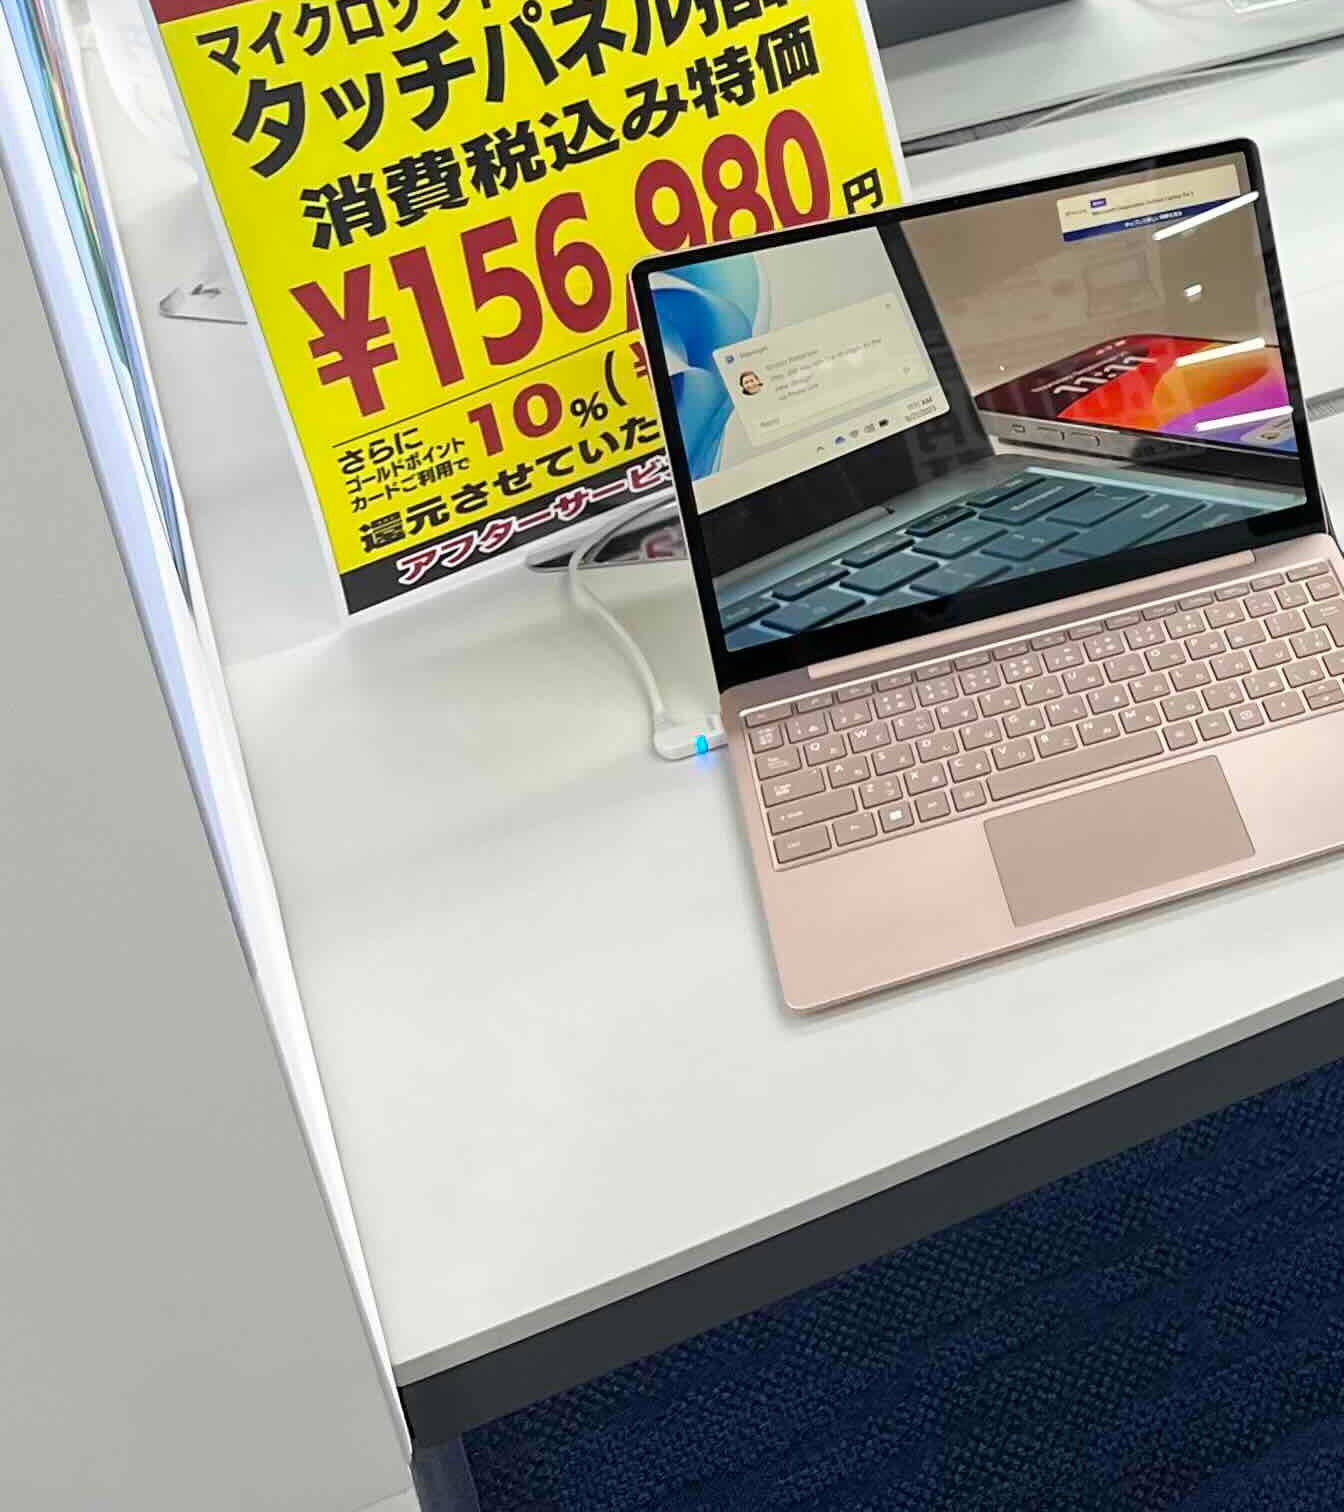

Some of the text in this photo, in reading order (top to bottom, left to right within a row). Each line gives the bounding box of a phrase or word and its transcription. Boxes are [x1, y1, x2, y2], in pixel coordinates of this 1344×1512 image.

[299, 19, 820, 250] 消費税込み特価
[338, 427, 424, 476] さらに
[345, 436, 466, 496] ゴールドポイント
[350, 457, 471, 514] カードご利用で
